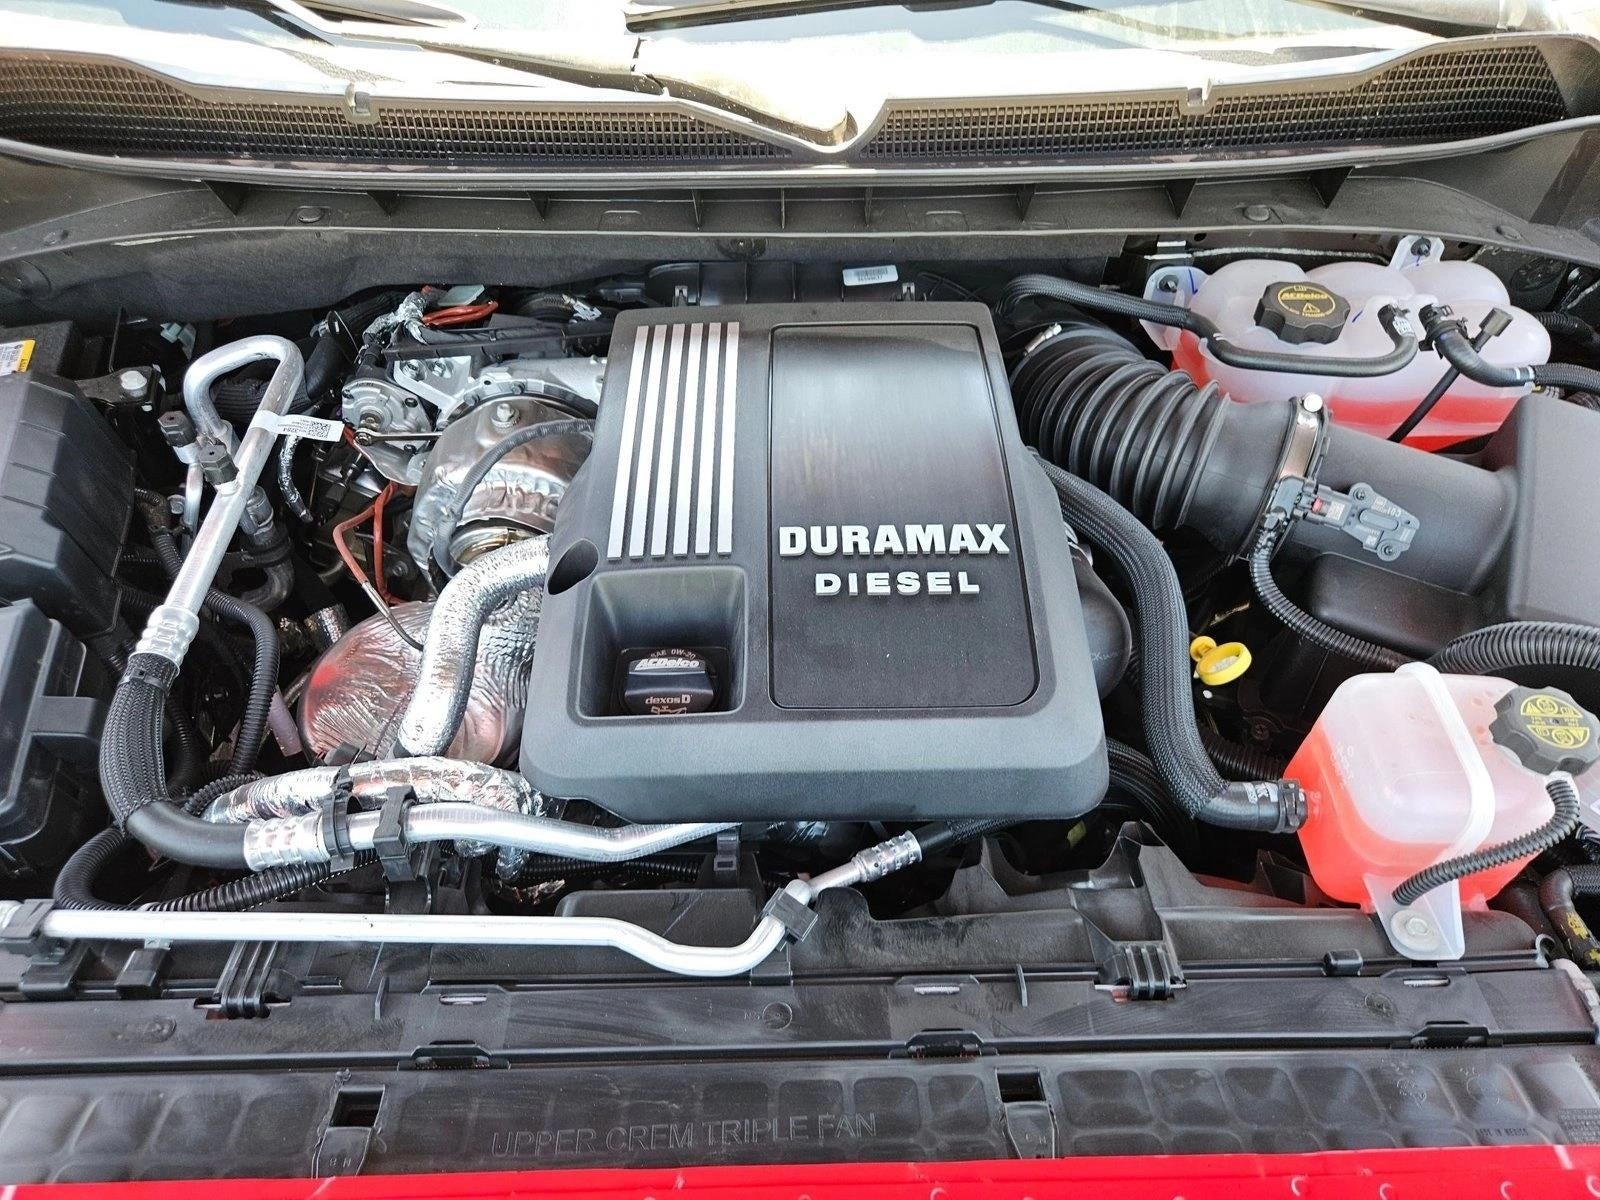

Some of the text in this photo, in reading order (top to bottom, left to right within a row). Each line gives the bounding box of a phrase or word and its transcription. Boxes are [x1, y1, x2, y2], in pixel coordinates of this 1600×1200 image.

[779, 523, 1010, 556] DURAMAX
[815, 571, 980, 596] DIESEL
[634, 657, 700, 671] ACDelco
[491, 1127, 597, 1158] UPPER
[702, 1115, 808, 1146] TRIPLE
[818, 1112, 877, 1142] FAN
